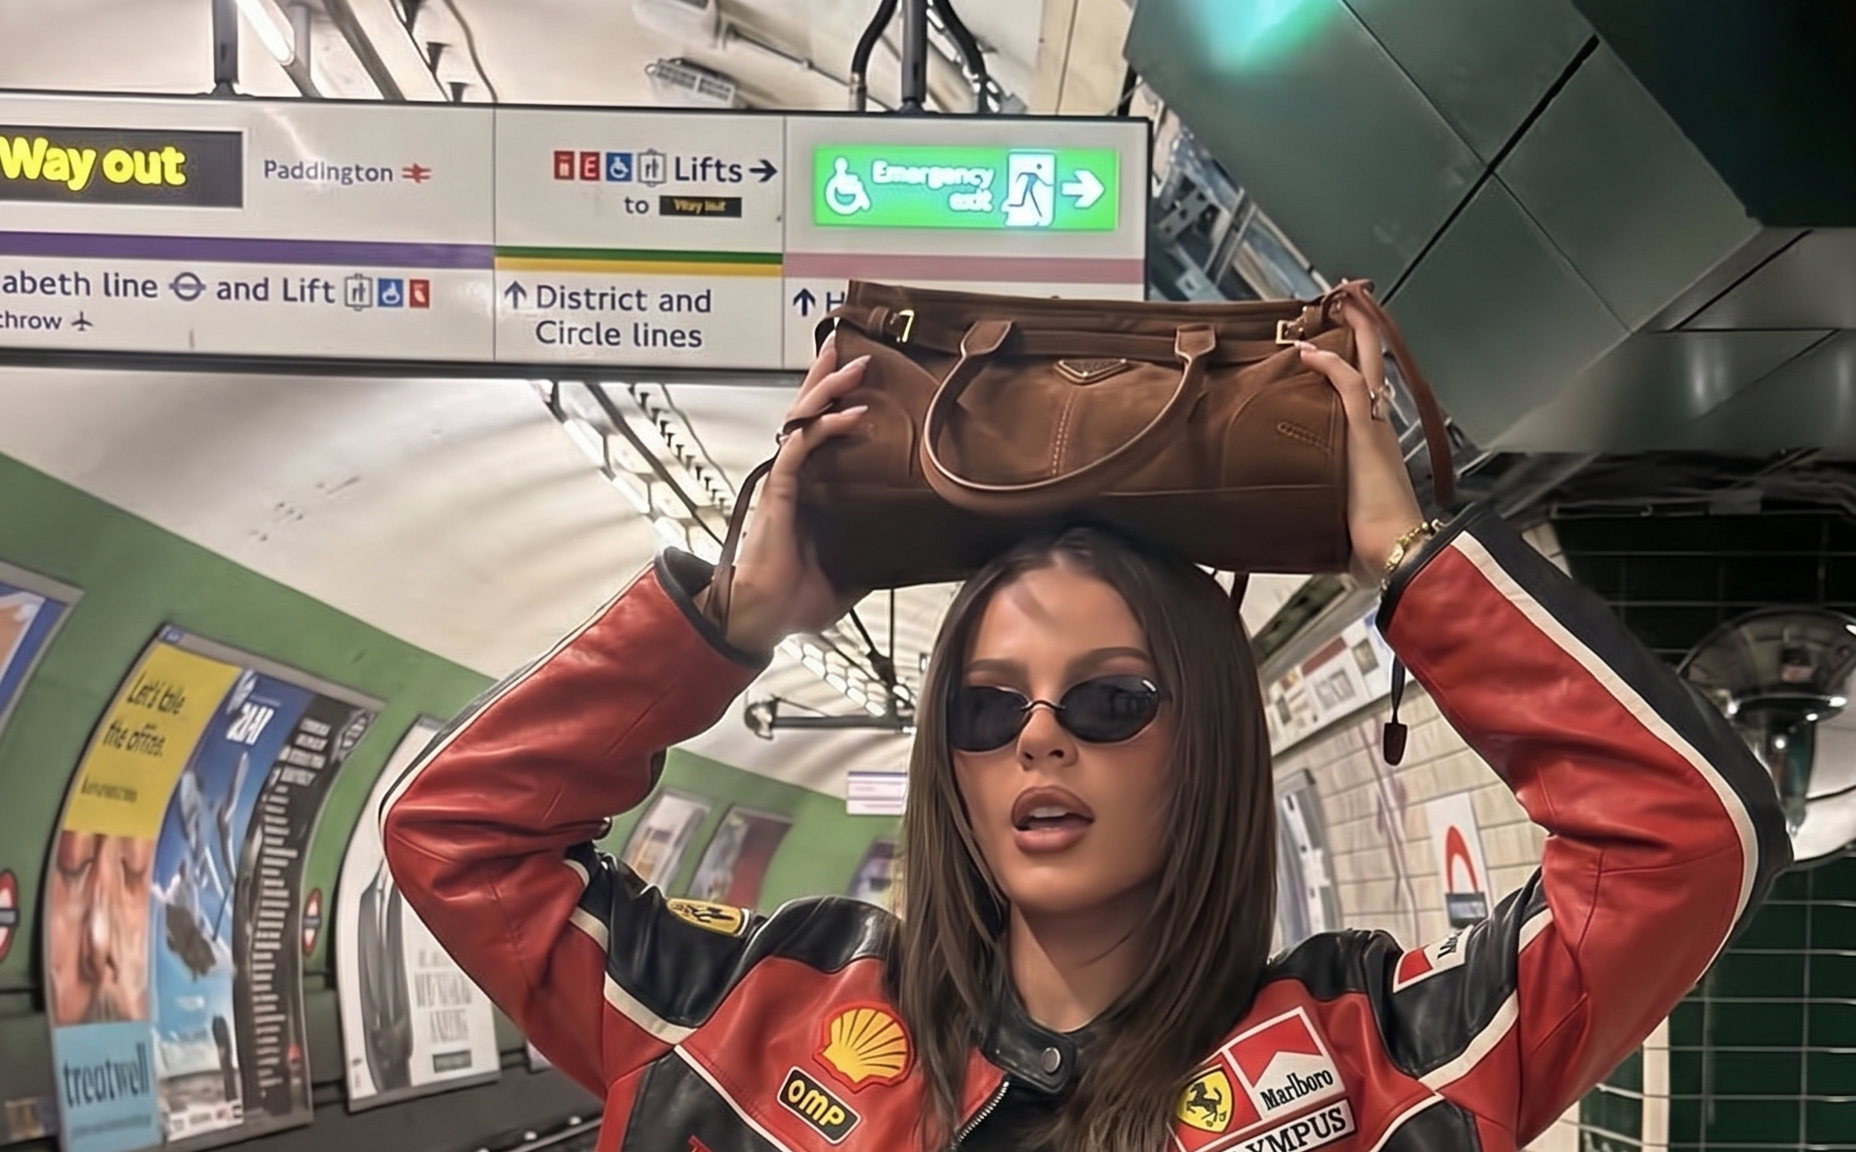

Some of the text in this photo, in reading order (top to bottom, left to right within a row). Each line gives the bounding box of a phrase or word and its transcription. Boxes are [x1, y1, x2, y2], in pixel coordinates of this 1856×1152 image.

[0, 136, 187, 191] Way out
[263, 159, 394, 186] Paddington
[675, 155, 743, 183] Lifts
[624, 197, 650, 215] to
[103, 272, 158, 298] line
[216, 277, 269, 301] and
[283, 277, 336, 304] Lift
[535, 285, 712, 314] District and
[535, 319, 703, 348] Circle lines
[63, 1042, 149, 1109] treatwell
[1260, 1069, 1334, 1111] Marlboro
[786, 1078, 846, 1129] OMP
